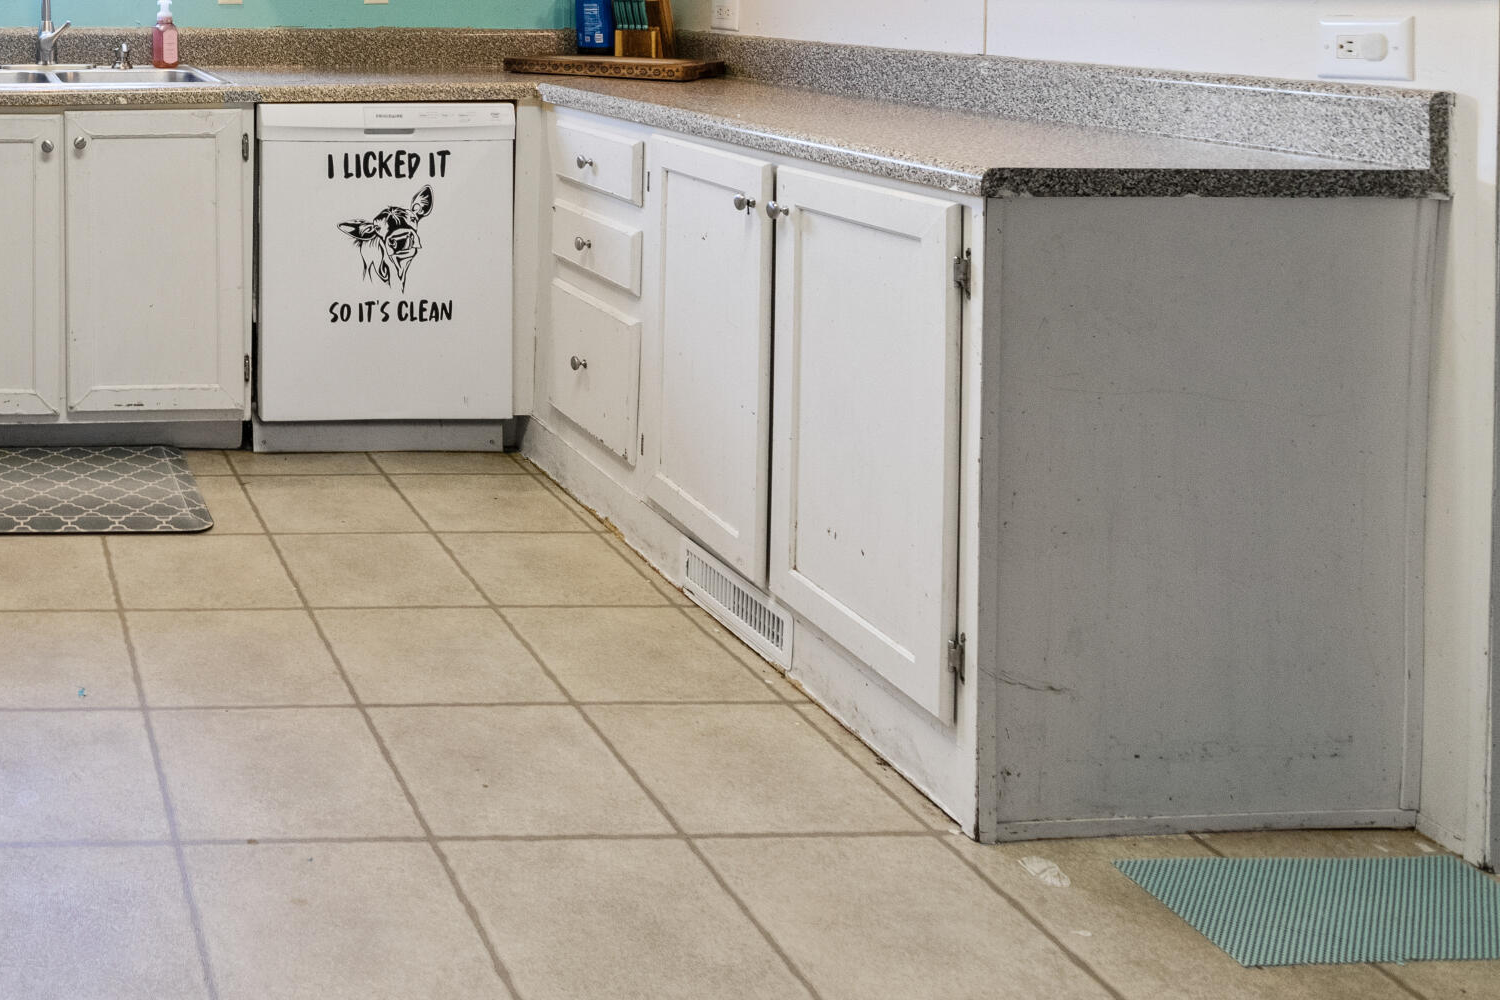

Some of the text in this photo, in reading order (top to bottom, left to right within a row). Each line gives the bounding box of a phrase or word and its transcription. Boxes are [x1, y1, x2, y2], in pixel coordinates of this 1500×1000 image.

[327, 150, 451, 179] I LICKED IT
[329, 300, 452, 323] SO IT'S CLEAN
